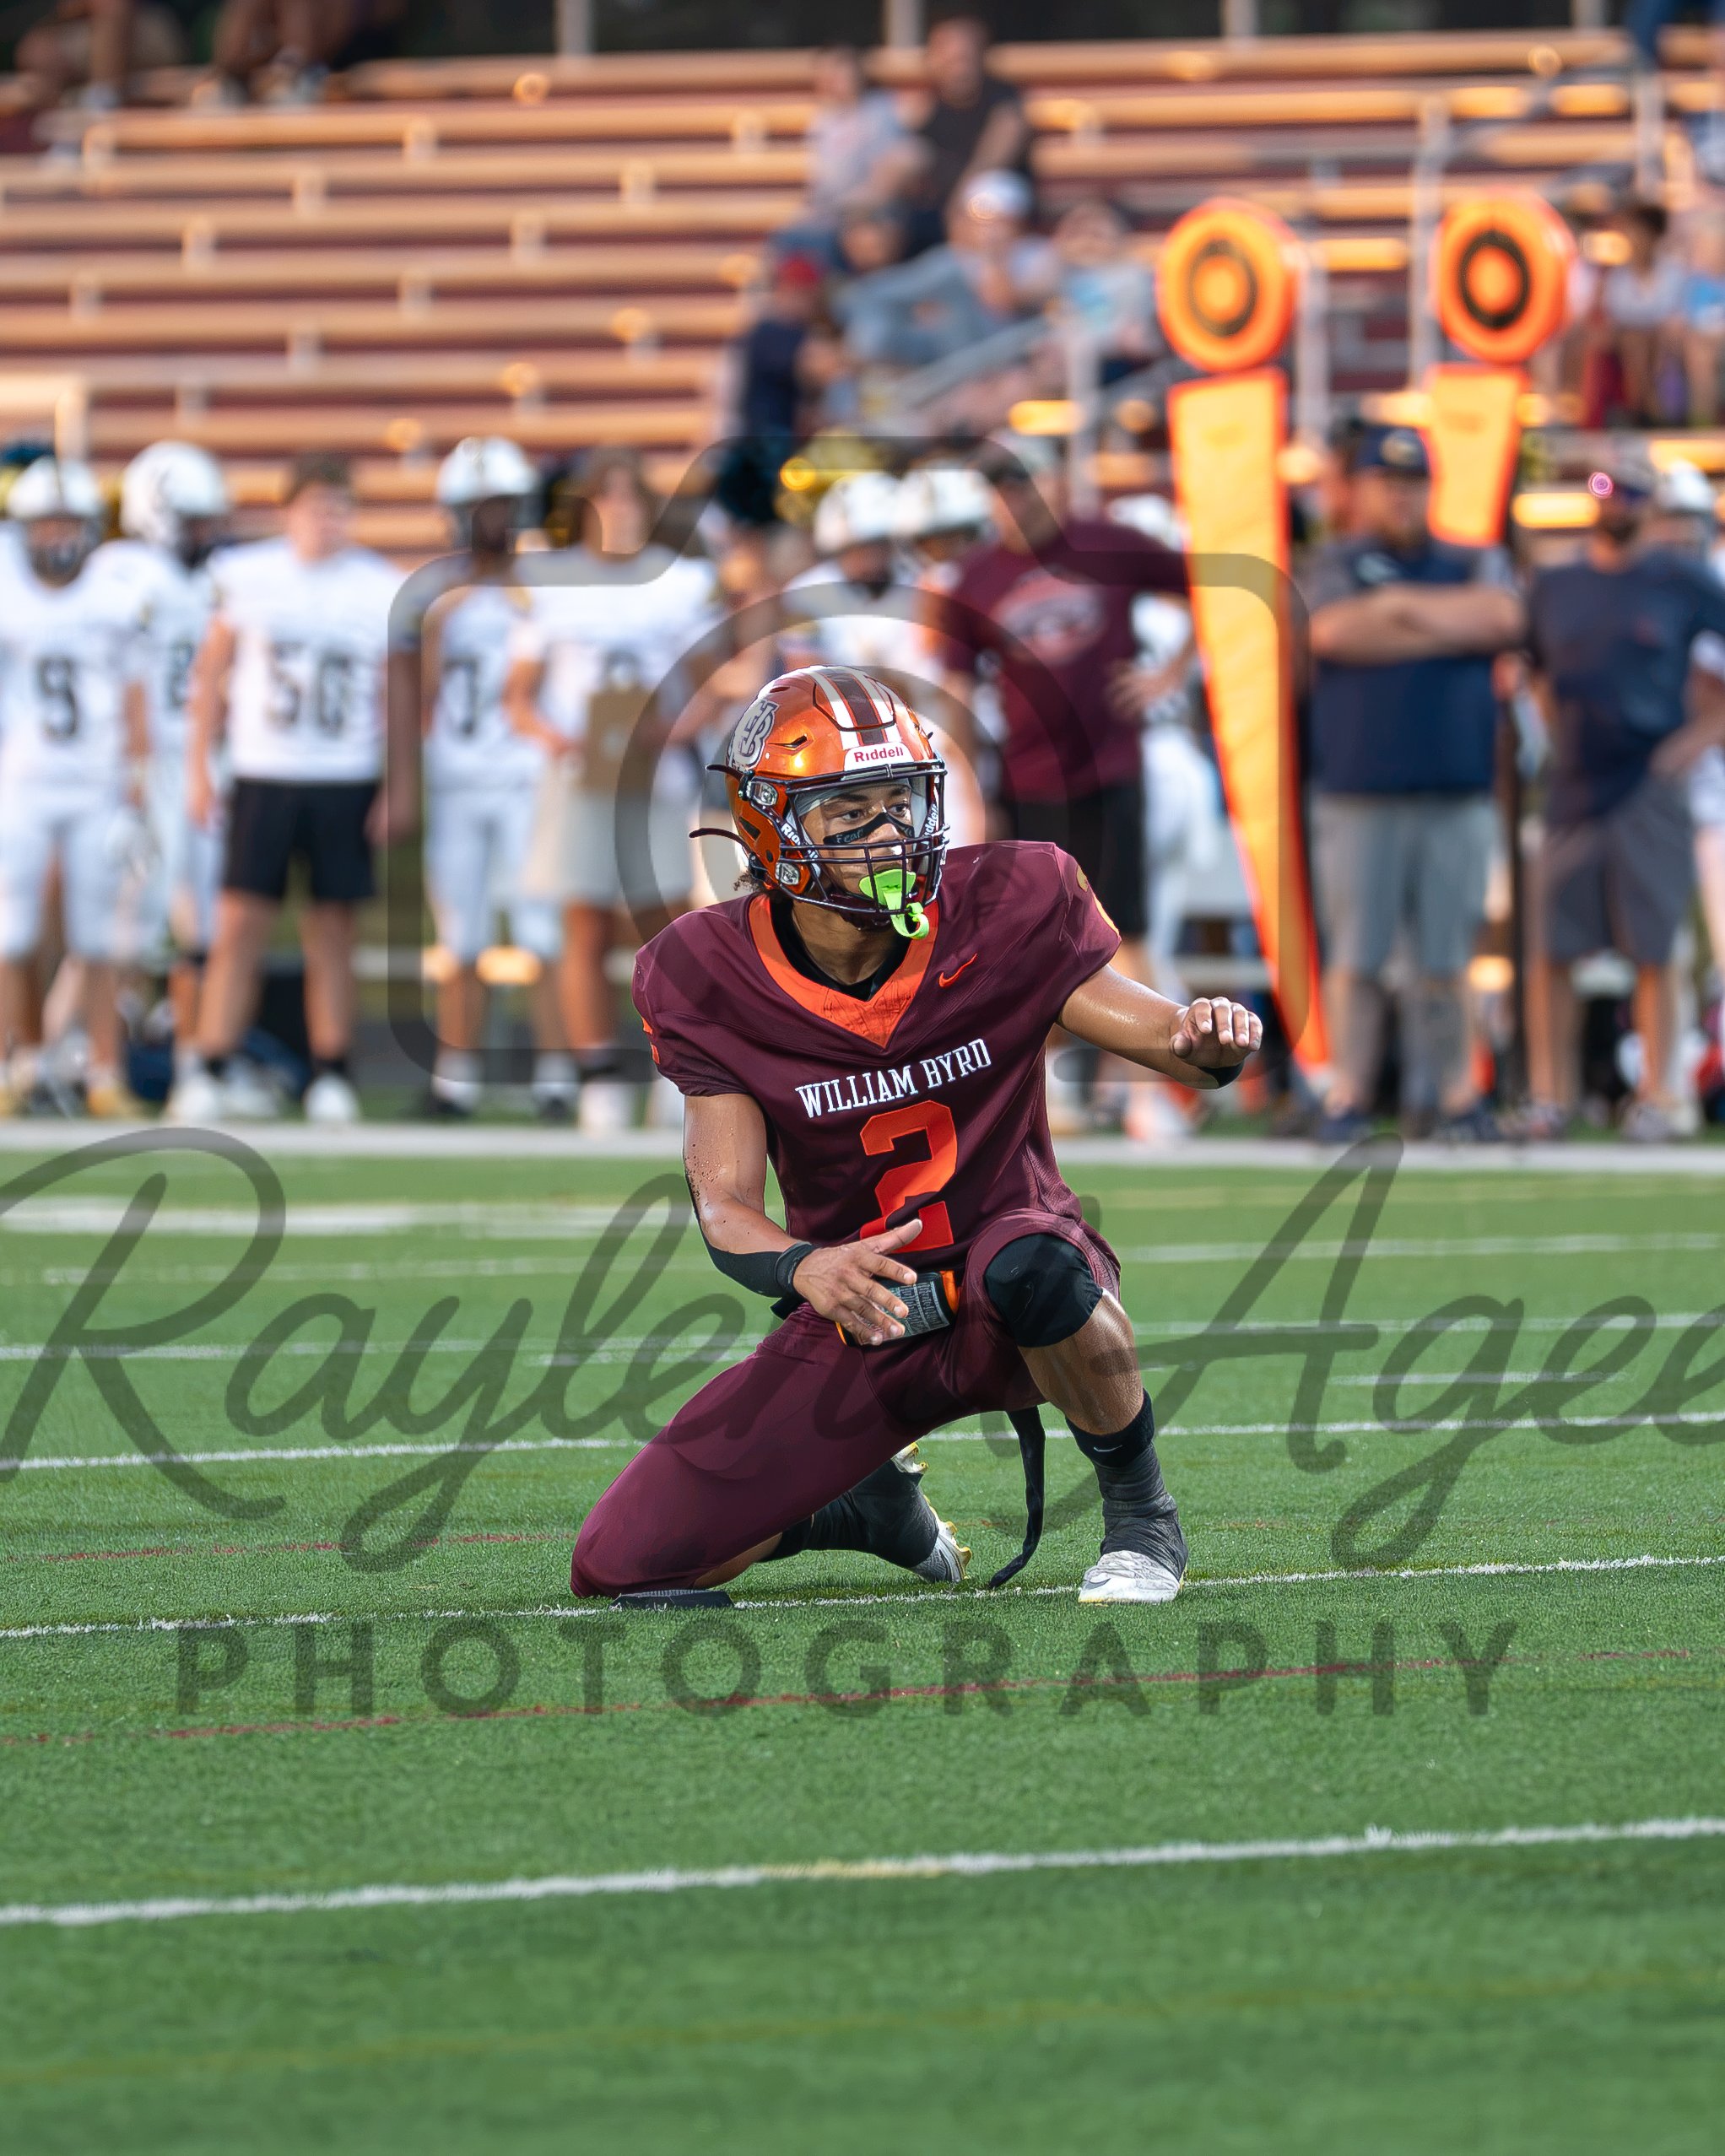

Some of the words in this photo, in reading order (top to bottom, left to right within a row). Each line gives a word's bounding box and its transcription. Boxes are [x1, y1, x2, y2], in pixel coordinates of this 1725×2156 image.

[853, 747, 904, 763] Riddell
[795, 1065, 919, 1119] WILLIAM
[919, 1038, 992, 1089] BYRD
[859, 1100, 958, 1254] 2
